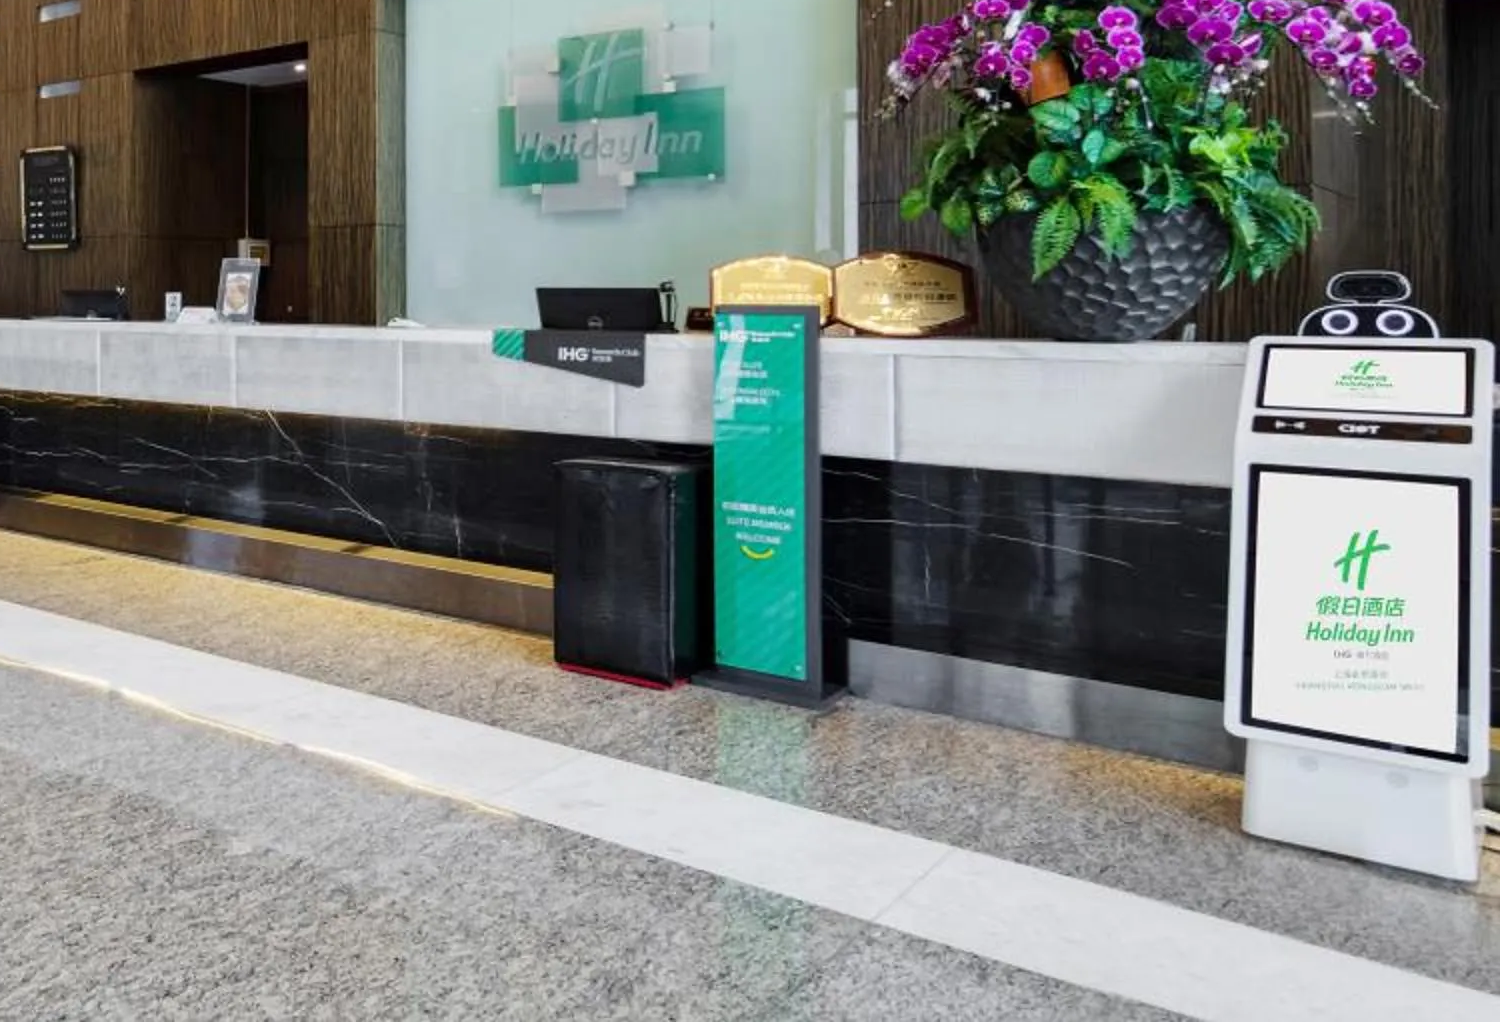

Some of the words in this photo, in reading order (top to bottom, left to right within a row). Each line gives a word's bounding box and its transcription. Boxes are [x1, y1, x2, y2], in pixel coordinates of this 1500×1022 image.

[519, 131, 638, 164] Holiday
[644, 121, 703, 156] Inn
[558, 347, 589, 362] IHG
[1316, 596, 1406, 617] 假日酒店
[1306, 621, 1381, 646] Holiday
[1384, 623, 1415, 643] Inn
